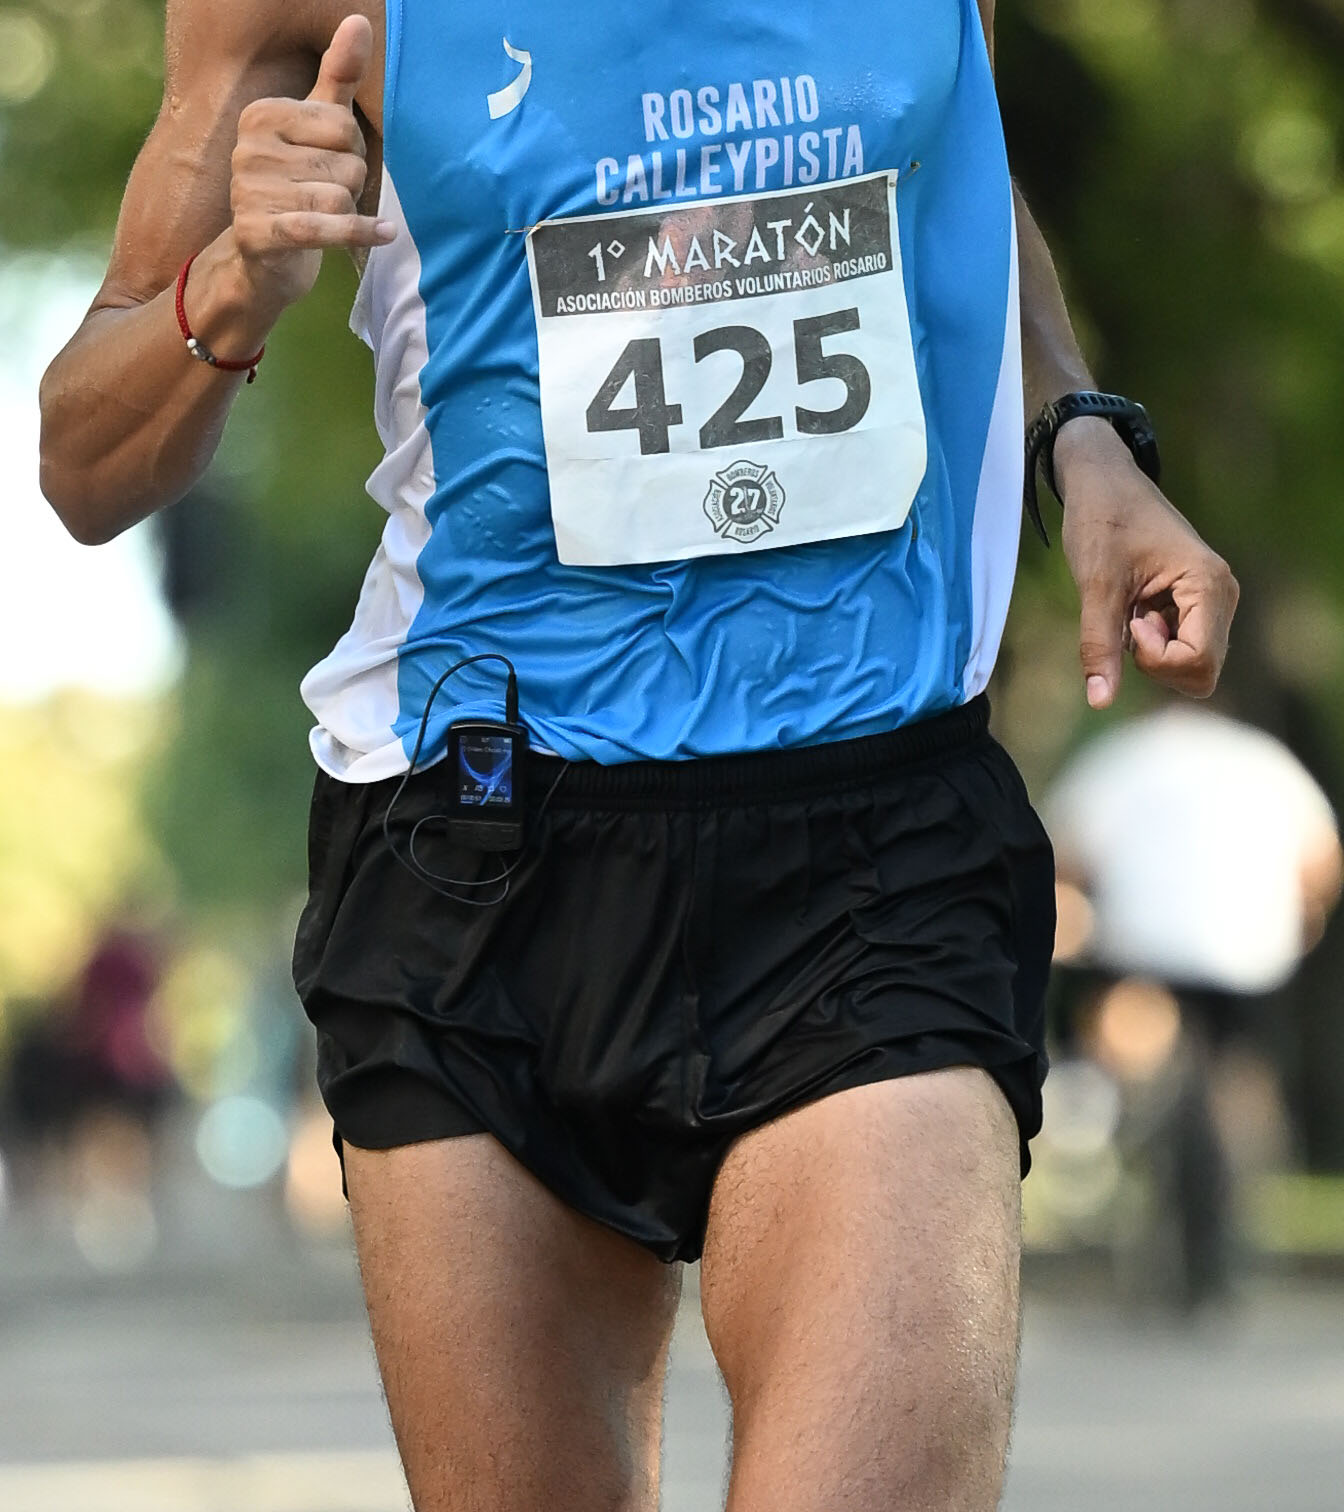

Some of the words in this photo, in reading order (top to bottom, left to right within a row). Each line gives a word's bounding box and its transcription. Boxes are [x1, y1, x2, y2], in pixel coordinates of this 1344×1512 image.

[641, 74, 819, 143] ROSARIO
[595, 124, 864, 206] CALLEYPISTA
[643, 201, 851, 278] MARATÓN
[556, 287, 646, 314] ASOCIACIÓN
[650, 279, 732, 306] BOMBEROS
[735, 266, 831, 296] VOLUNTARIOS
[833, 252, 887, 280] ROSARIO
[585, 307, 872, 456] 425
[729, 487, 761, 515] 27
